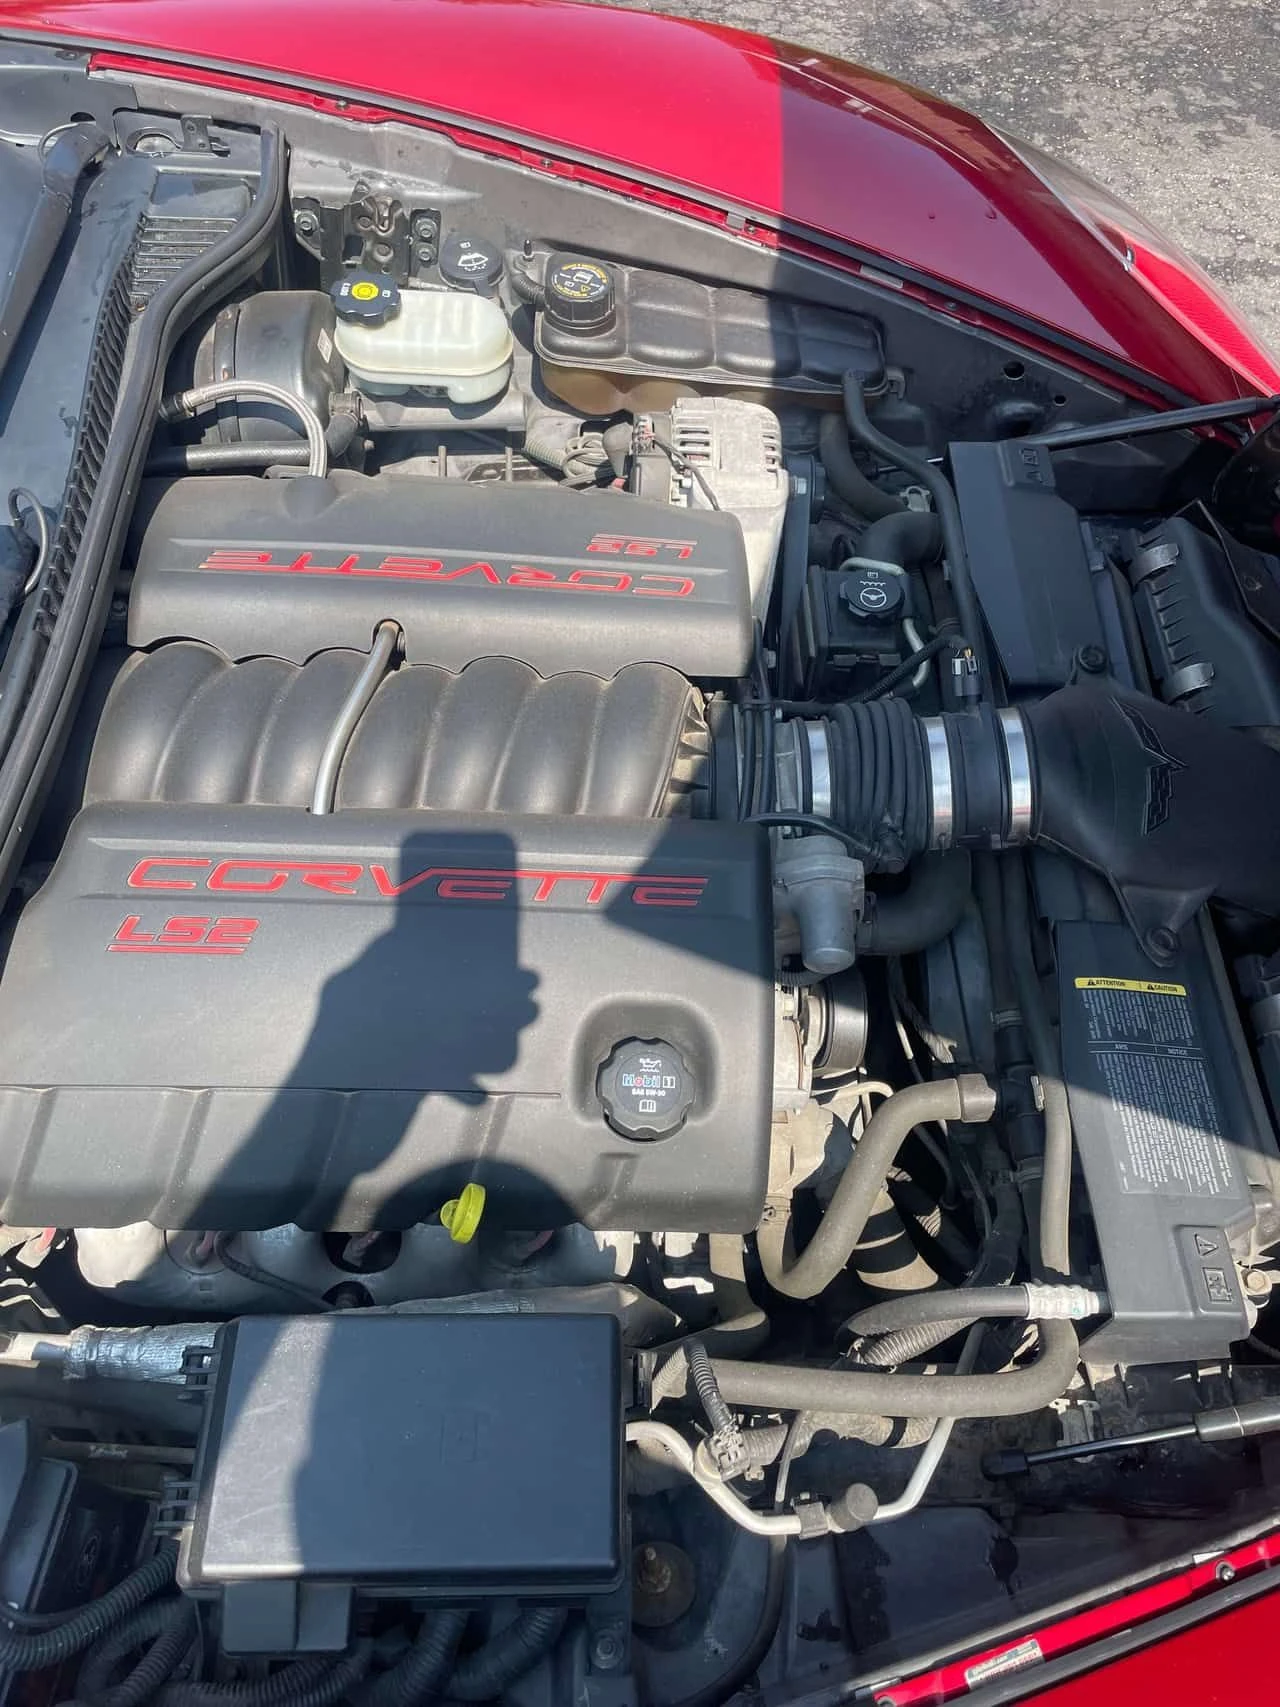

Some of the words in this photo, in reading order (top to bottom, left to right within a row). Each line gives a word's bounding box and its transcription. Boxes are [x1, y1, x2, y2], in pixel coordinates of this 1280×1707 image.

[586, 536, 695, 559] LS2
[198, 550, 695, 597] CORVETTE
[127, 856, 709, 906] CORVETTE
[113, 914, 260, 944] LS2
[1095, 979, 1126, 987] ATTENTION
[622, 1073, 661, 1088] Mobil
